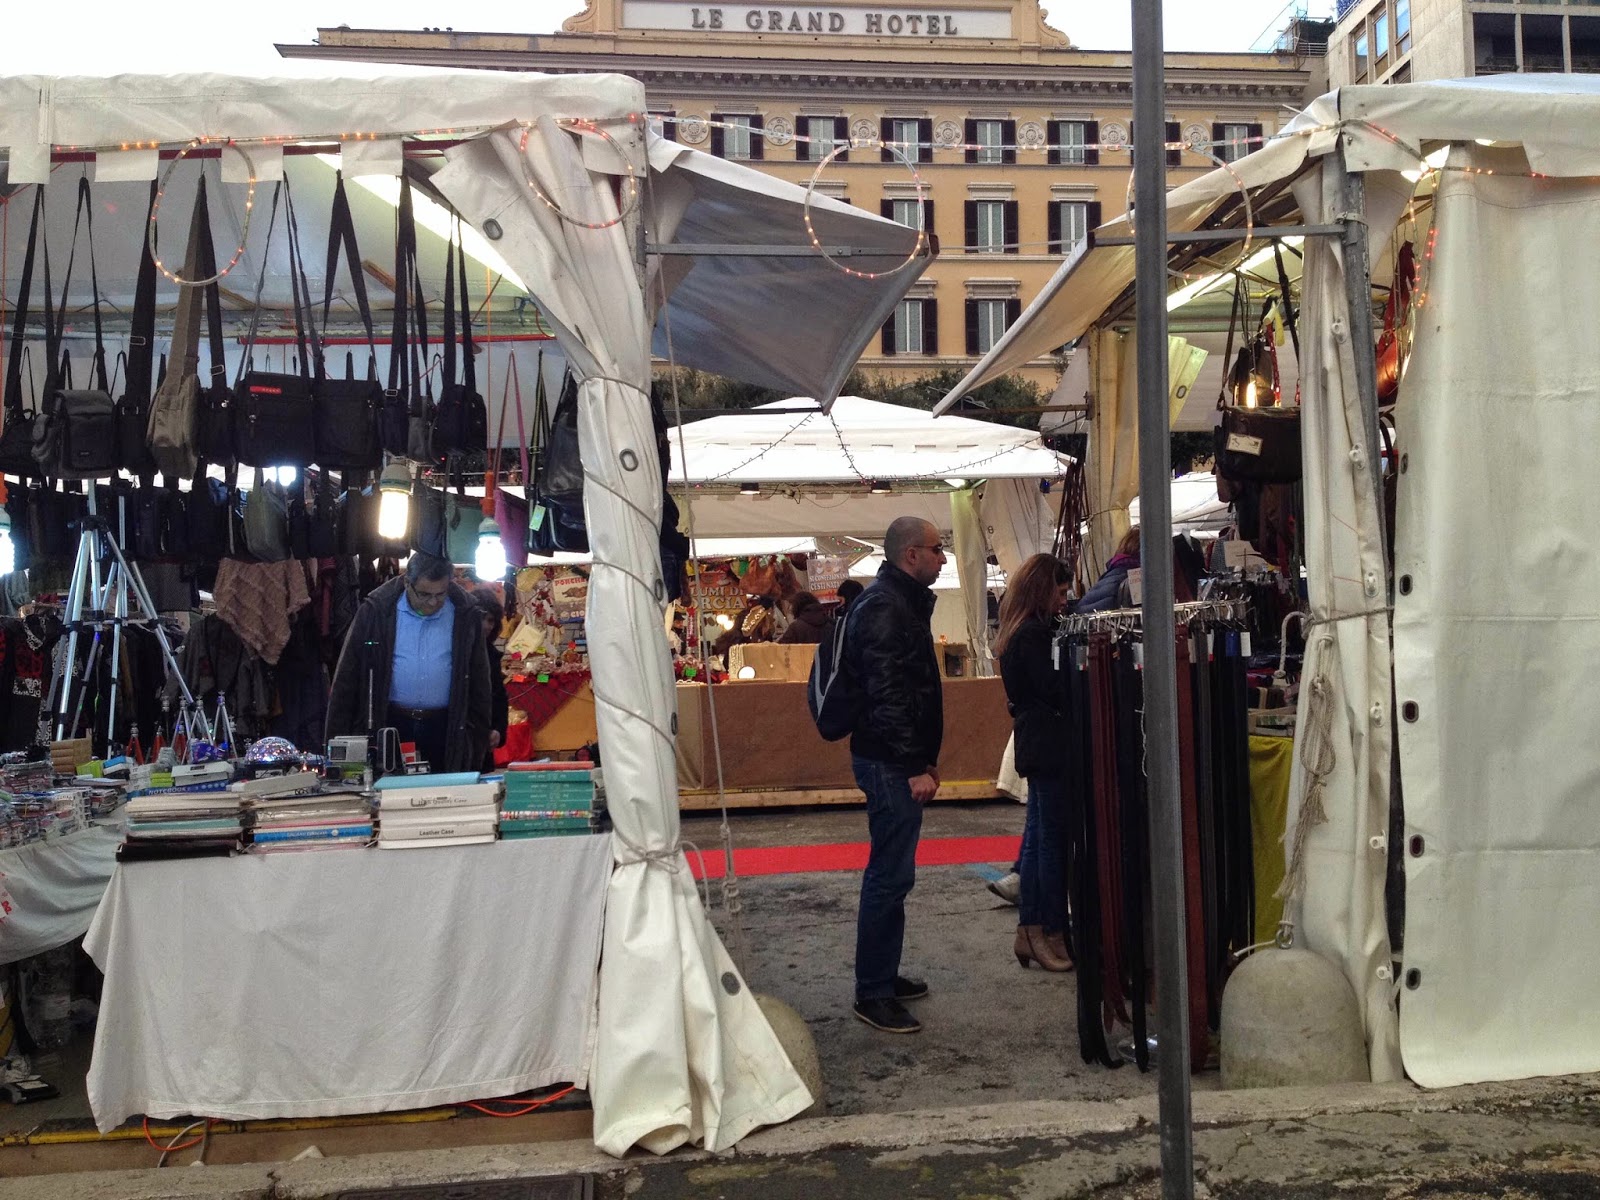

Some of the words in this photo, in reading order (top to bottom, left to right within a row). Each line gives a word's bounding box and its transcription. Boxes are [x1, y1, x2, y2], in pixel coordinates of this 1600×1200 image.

[691, 8, 723, 29] LE
[745, 10, 845, 32] GRAND
[865, 13, 958, 35] HOTEL
[690, 587, 725, 597] LUMI
[419, 829, 440, 837] Leather
